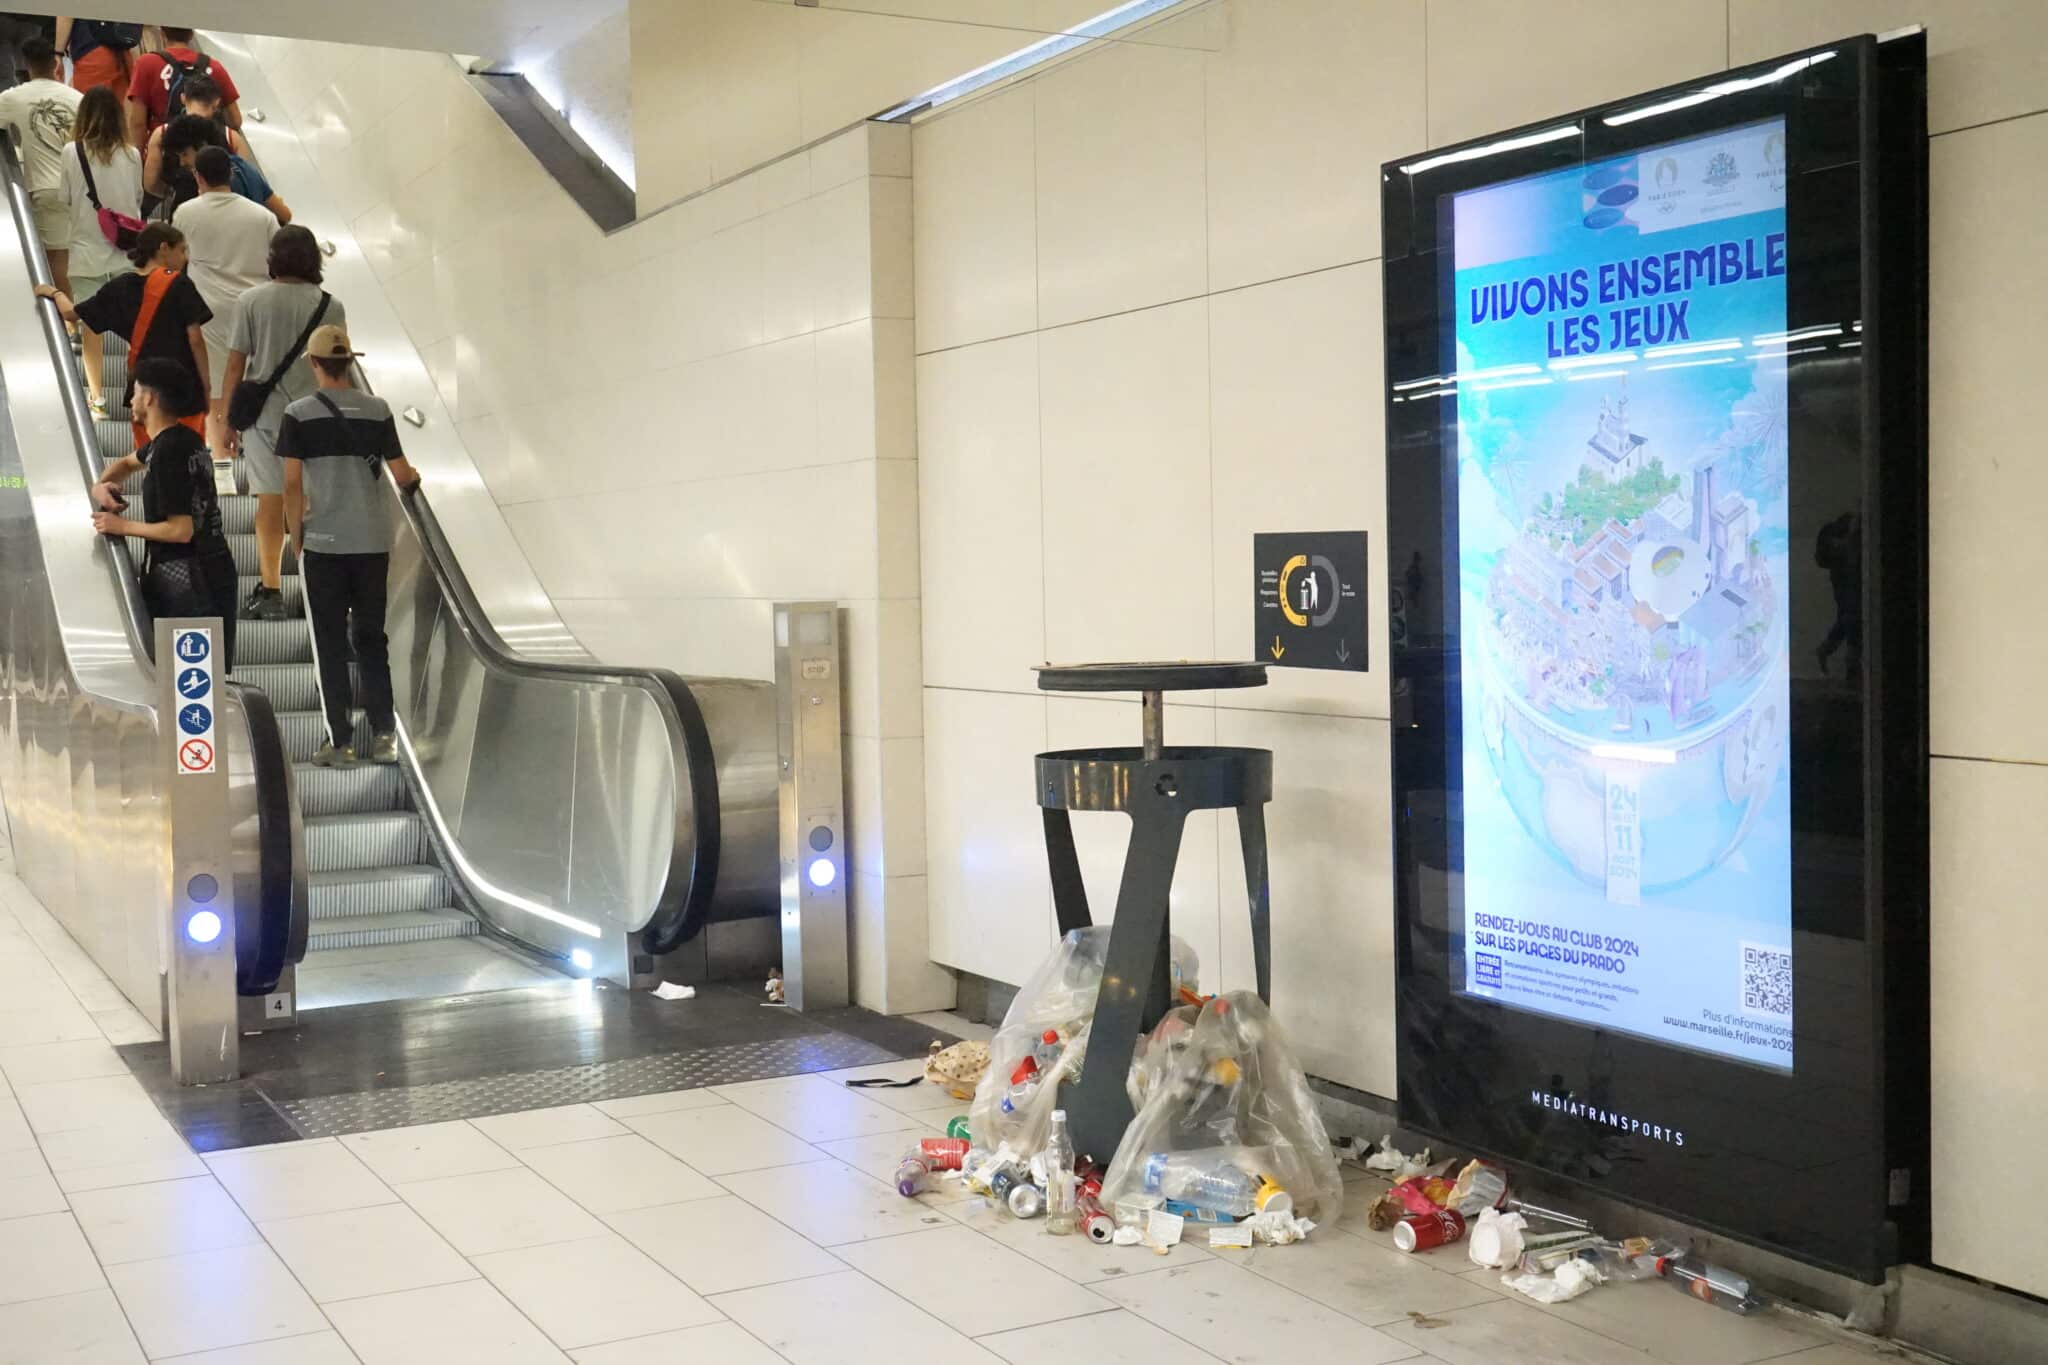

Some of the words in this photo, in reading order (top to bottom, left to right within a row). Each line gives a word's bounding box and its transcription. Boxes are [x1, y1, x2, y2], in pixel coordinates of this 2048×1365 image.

[1471, 268, 1589, 325] VIVONS
[1599, 232, 1785, 304] ENSEMBLE
[1546, 314, 1600, 359] LES
[1609, 299, 1690, 350] JEUX
[1474, 911, 1551, 940] RENDEZ-VOUS
[1552, 926, 1569, 943] AU
[1569, 929, 1603, 950] CLUB
[1604, 936, 1640, 958] 2024
[1474, 930, 1498, 949] SUR
[1498, 935, 1517, 952] LES
[1517, 939, 1563, 962] PLAGES
[1562, 949, 1580, 965] DU
[1580, 951, 1626, 974] PRADO
[273, 999, 283, 1011] 4
[1702, 1008, 1722, 1023] Plus
[1531, 1089, 1685, 1147] MEDIATRANSPORTS
